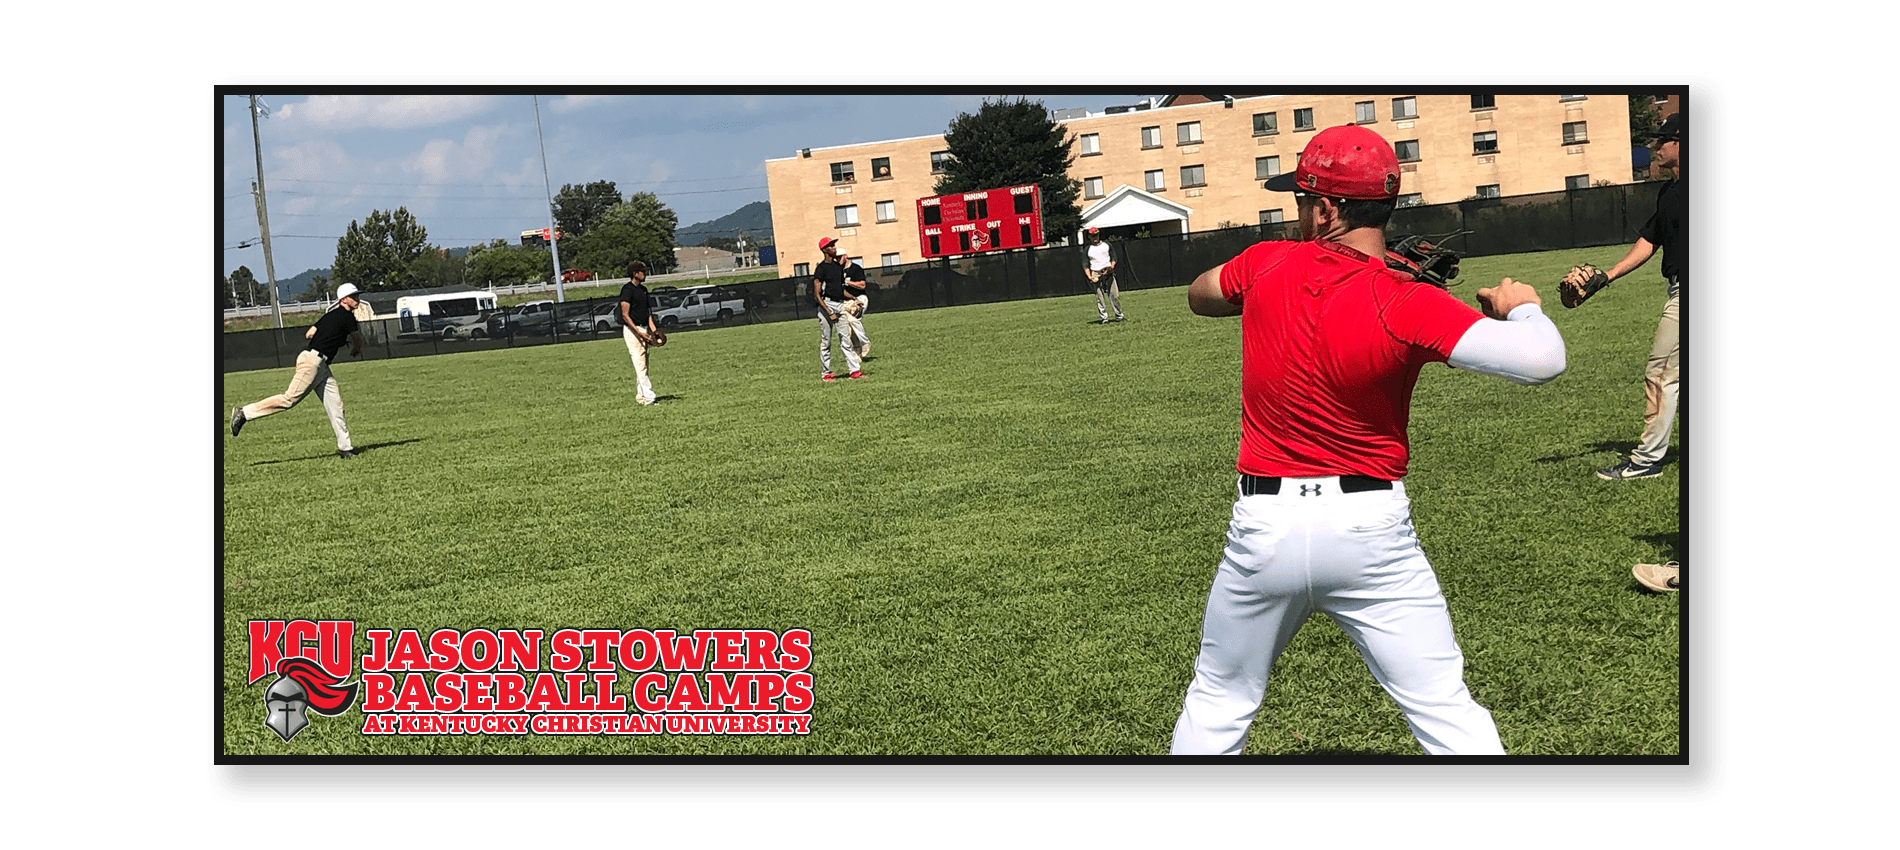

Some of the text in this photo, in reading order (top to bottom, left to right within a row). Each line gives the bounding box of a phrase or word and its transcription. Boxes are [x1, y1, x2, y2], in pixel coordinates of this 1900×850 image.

[921, 186, 1034, 206] HOME INNING GUEST
[925, 227, 942, 236] BALL
[951, 223, 976, 233] STRIKE
[986, 220, 1001, 228] OUT
